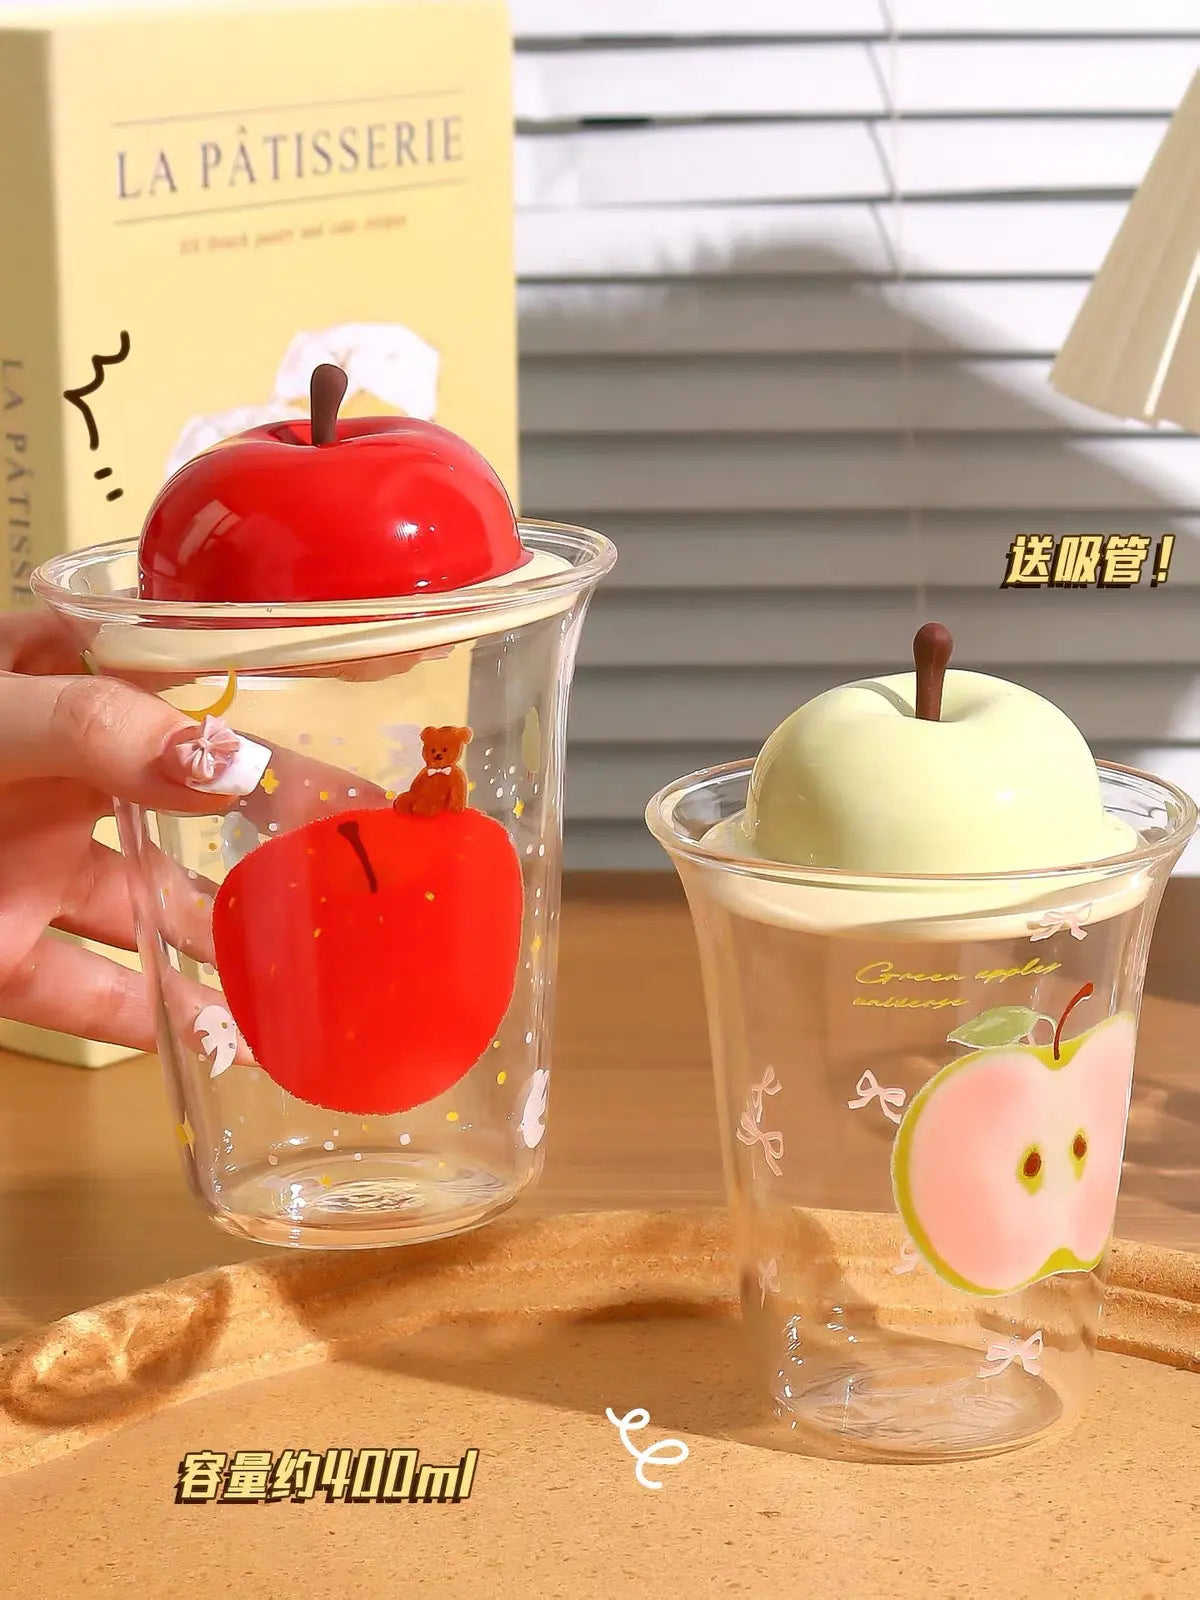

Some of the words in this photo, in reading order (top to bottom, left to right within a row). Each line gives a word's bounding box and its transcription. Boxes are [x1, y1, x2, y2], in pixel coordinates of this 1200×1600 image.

[116, 149, 178, 200] LA
[200, 115, 464, 190] PÂTISSERIE
[2, 359, 25, 411] LA
[855, 961, 966, 985] Green
[974, 957, 1063, 984] apples
